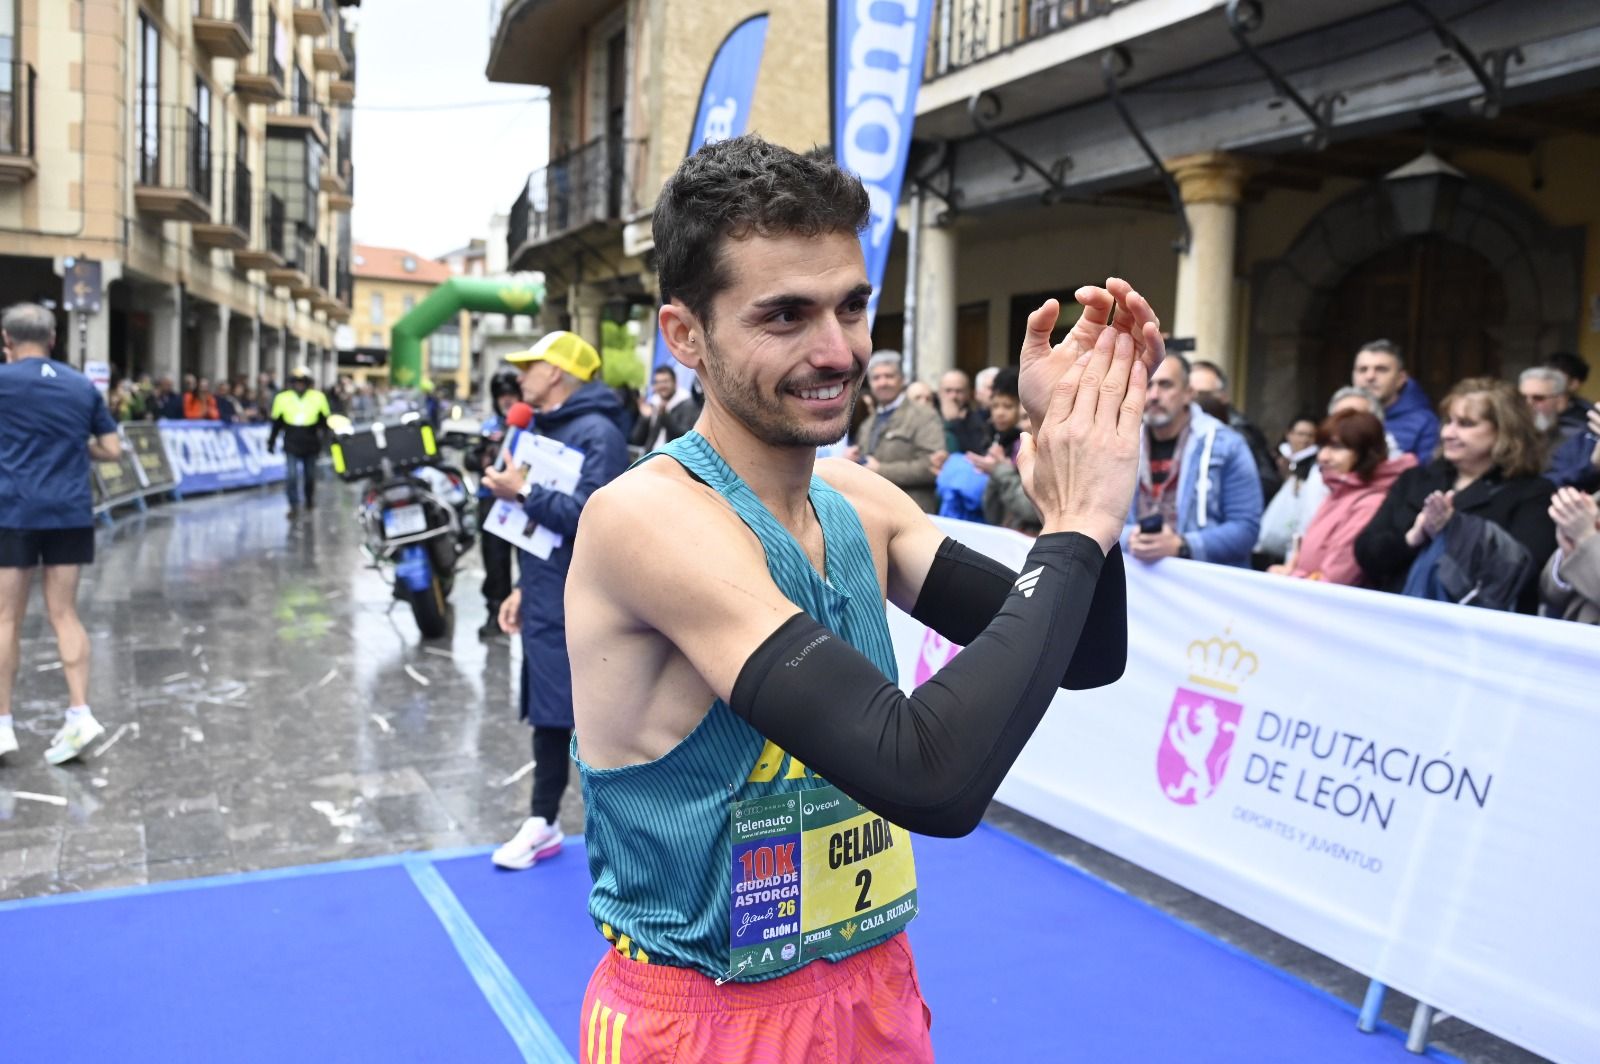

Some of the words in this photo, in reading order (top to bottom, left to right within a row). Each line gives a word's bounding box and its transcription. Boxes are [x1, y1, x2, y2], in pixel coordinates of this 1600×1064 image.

[1256, 710, 1493, 809] DIPUTACIÓN
[815, 799, 840, 812] VEOLIA
[1244, 753, 1288, 794] DE
[1294, 768, 1395, 830] LEÓN
[736, 814, 793, 834] Telenauto
[1231, 805, 1296, 842] DEPORTES
[1298, 830, 1308, 844] Y
[1307, 834, 1383, 874] JUVENTUD
[738, 842, 796, 883] 10K
[828, 819, 893, 870] CELADA
[735, 884, 799, 908] ASTORGA
[736, 875, 781, 894] CIUDAD
[784, 871, 798, 884] DE
[855, 869, 872, 912] 2
[763, 923, 791, 939] CAJÓN
[792, 921, 799, 933] A
[860, 914, 885, 932] CAJA
[886, 899, 914, 920] RURAL
